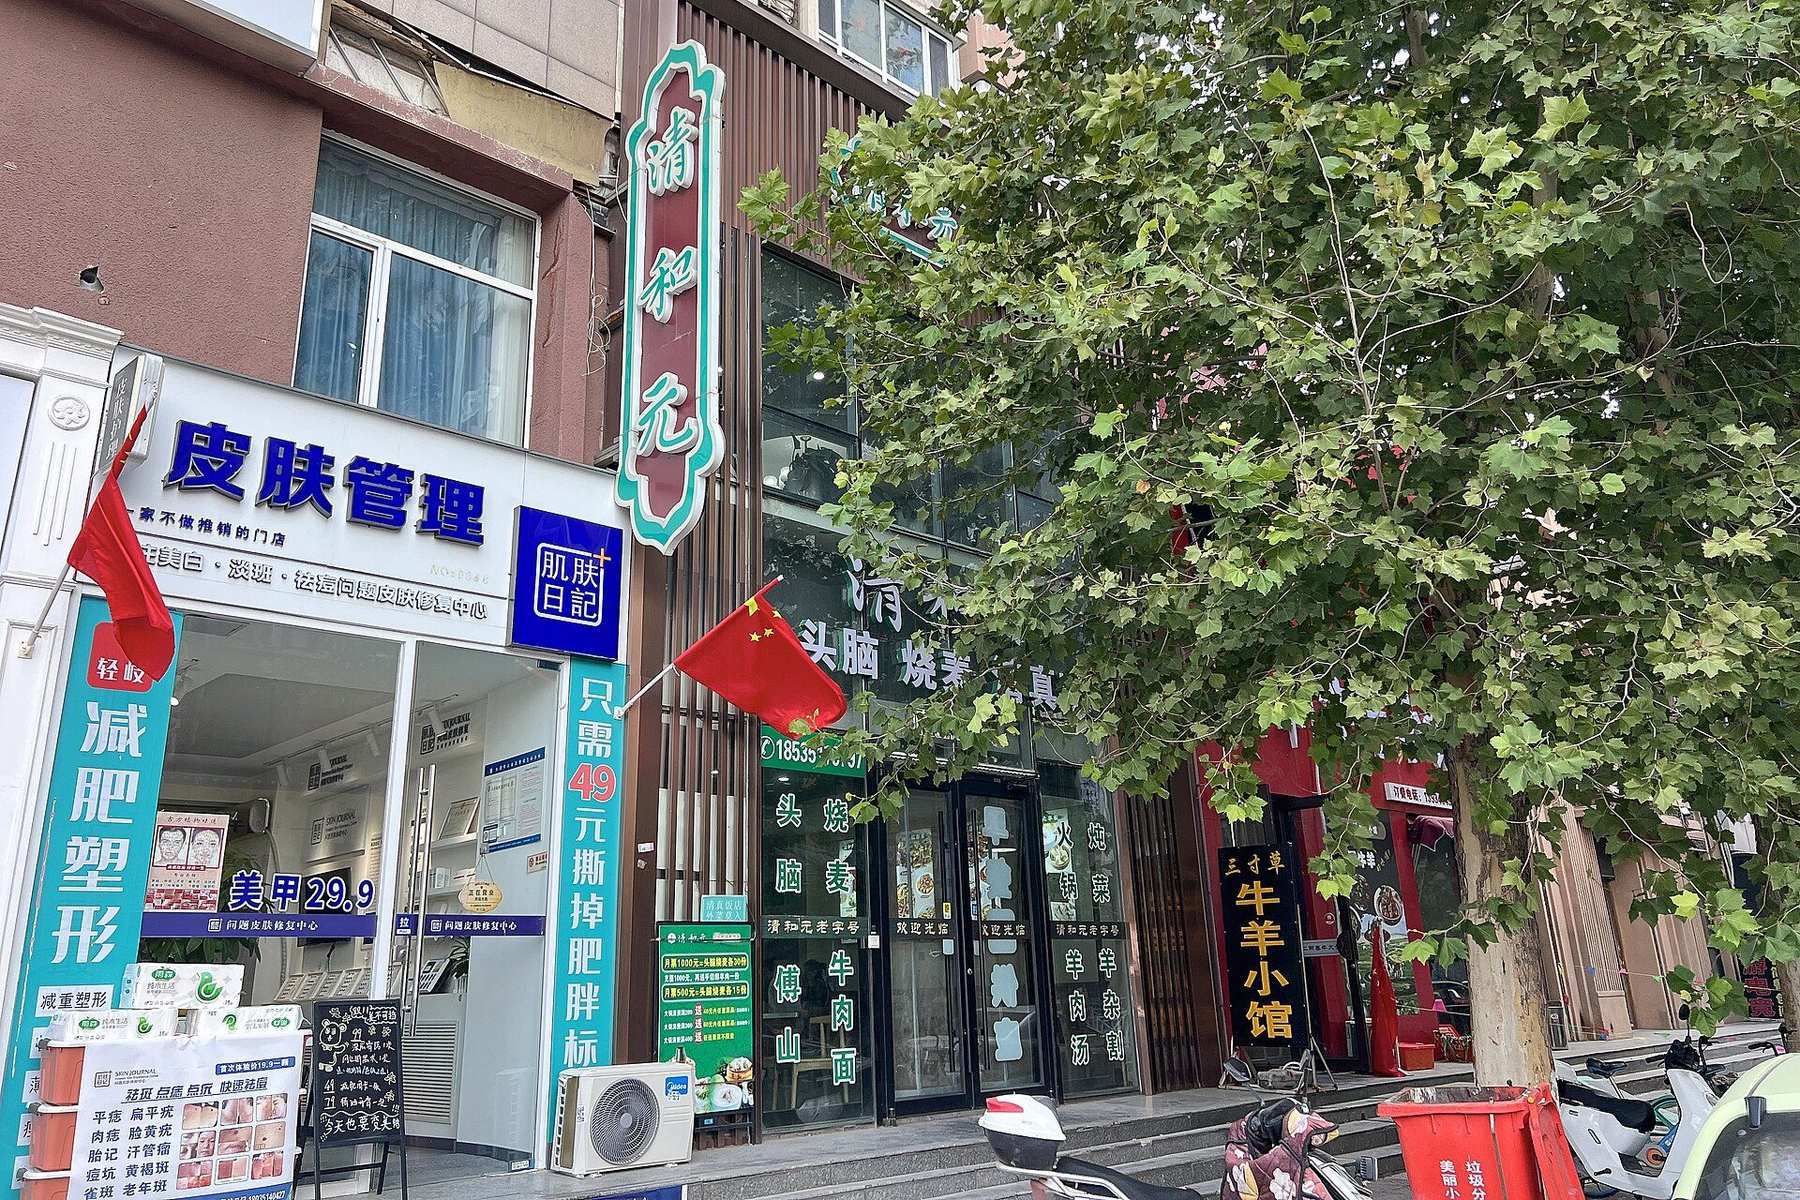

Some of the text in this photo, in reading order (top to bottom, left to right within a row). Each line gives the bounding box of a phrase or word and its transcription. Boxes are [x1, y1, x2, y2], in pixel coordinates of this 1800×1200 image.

[637, 106, 699, 455] 清和元
[164, 420, 484, 548] 皮肤管理
[127, 506, 286, 547] 一家不做推销的门店
[541, 551, 599, 588] 肌肤
[543, 586, 598, 619] 日記
[799, 620, 879, 680] 头脑
[50, 700, 148, 964] 减肥塑形
[229, 870, 375, 913] 美甲29.9
[226, 919, 318, 931] 问题皮肤修复中心
[445, 920, 517, 932] 问题皮肤修复中心
[767, 919, 860, 934] 清和元老字号
[896, 920, 950, 935] 欢迎光临
[1056, 923, 1119, 937] 清和元老字号
[1235, 880, 1293, 1039] 牛羊小馆
[41, 991, 107, 1009] 减重塑形
[774, 964, 802, 1064] 傅山
[829, 949, 857, 1086] 牛肉面
[1065, 949, 1090, 1066] 羊肉汤
[1098, 948, 1125, 1061] 羊杂割
[220, 1077, 267, 1092] 快速祛痘
[93, 1105, 174, 1124] 平痣 扁平疣
[88, 1142, 171, 1162] 胎记 汗管瘤
[91, 1129, 120, 1143] 肉痣
[84, 1180, 167, 1200] 雀斑 老年斑
[86, 1161, 169, 1182] 痘坑 黄褐斑
[1440, 1160, 1460, 1199] 美丽小
[1465, 1160, 1486, 1200] 垃圾分
